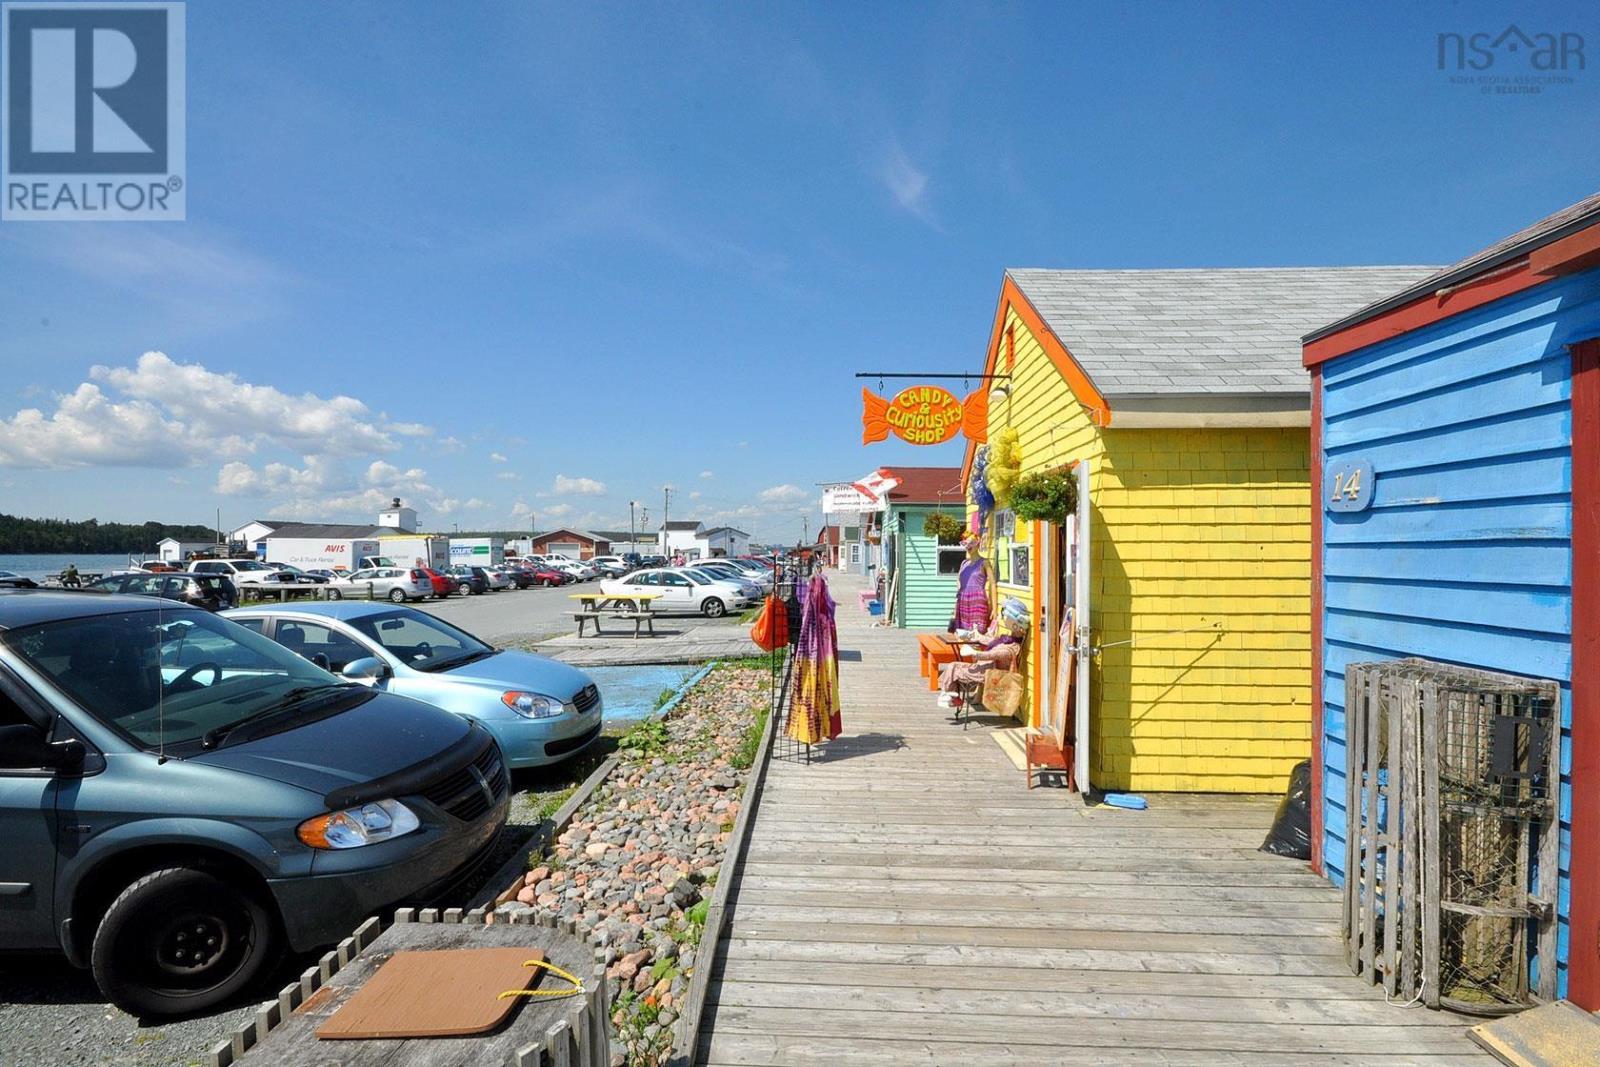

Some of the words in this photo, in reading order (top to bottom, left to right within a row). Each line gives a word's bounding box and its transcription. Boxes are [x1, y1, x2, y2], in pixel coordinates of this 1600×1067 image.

[900, 387, 952, 408] CANDY
[919, 402, 930, 415] &
[903, 427, 945, 443] SHOP
[1331, 469, 1361, 502] 14
[325, 544, 345, 552] AVIS
